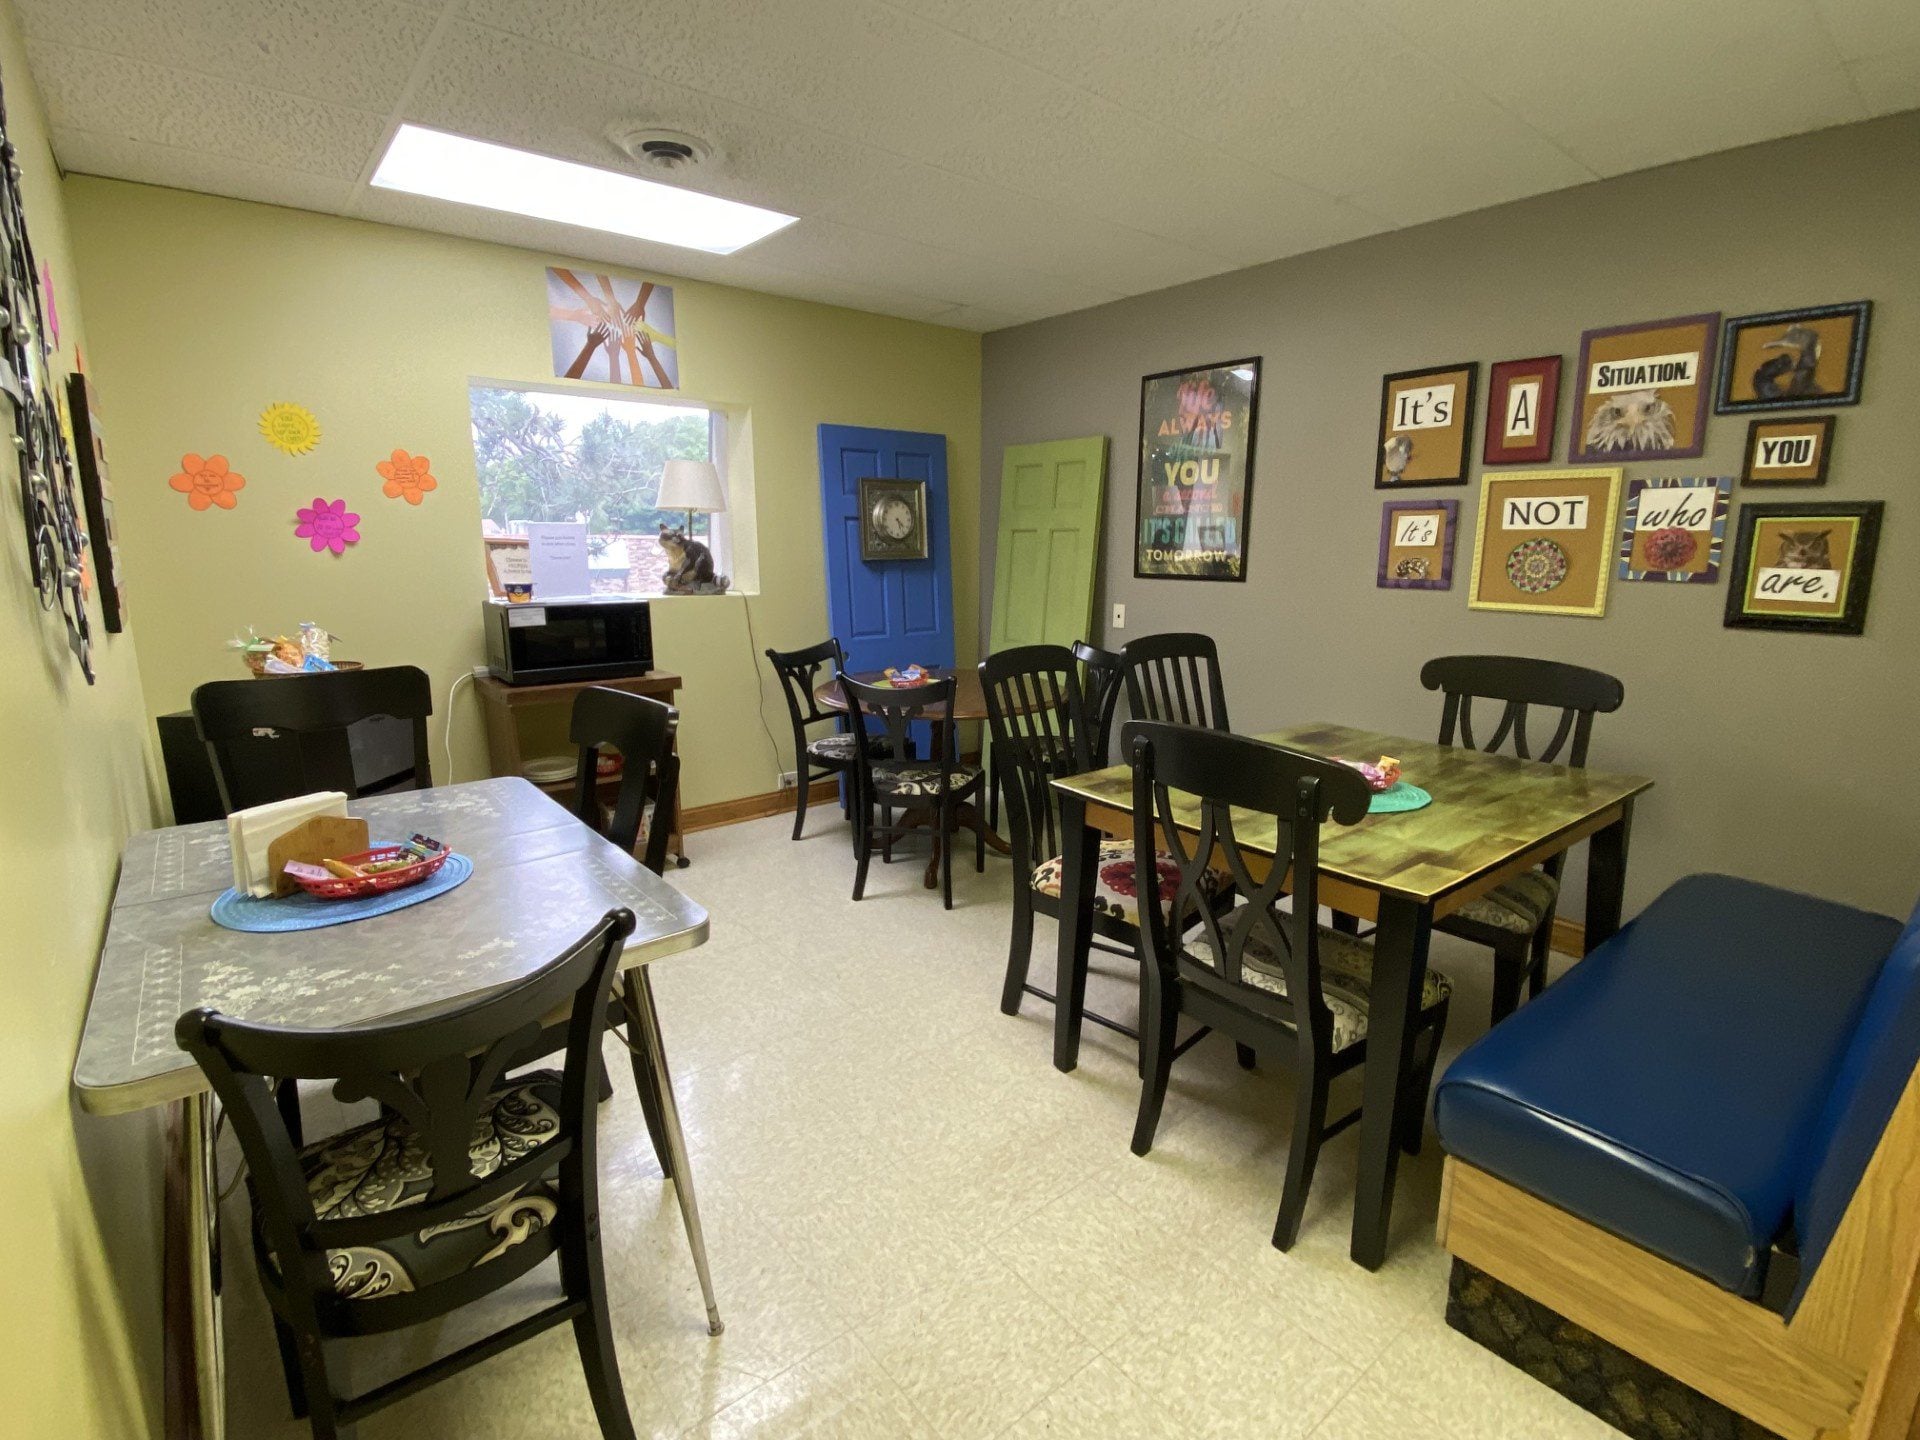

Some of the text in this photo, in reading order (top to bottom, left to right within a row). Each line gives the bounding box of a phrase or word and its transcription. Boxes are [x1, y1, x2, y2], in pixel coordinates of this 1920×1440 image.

[1397, 391, 1448, 427] It's
[1511, 389, 1530, 430] A
[1158, 410, 1232, 437] ALWAYS
[1762, 439, 1811, 465] YOU
[1164, 459, 1219, 486] YOU
[1509, 501, 1584, 525] NOT
[1642, 492, 1708, 528] who
[1400, 519, 1432, 543] It's
[1761, 573, 1829, 599] are.
